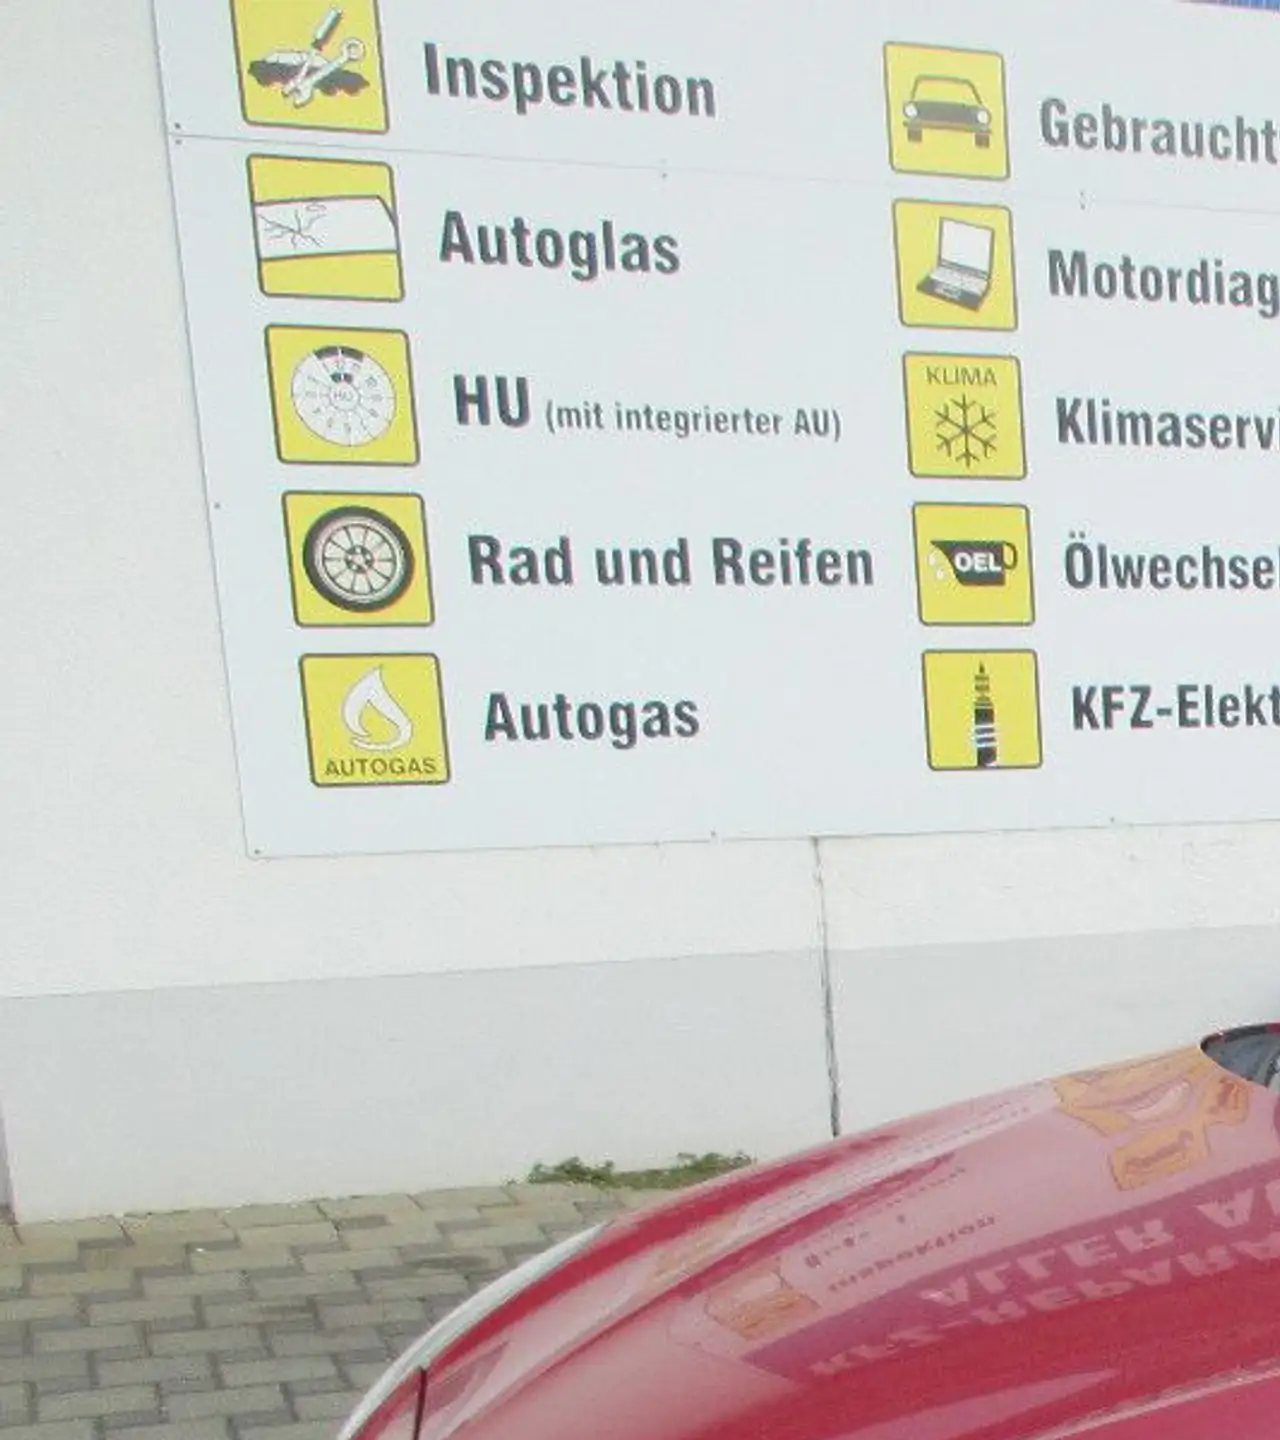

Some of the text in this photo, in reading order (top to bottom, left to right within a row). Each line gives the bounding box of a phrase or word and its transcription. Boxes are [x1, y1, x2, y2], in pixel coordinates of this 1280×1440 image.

[424, 42, 717, 117] Inspektion
[439, 210, 681, 282] Autoglas
[926, 365, 998, 387] KLIMA
[453, 373, 842, 442] HU (mit integrierter AU)
[467, 534, 875, 587] Rad und Reifen
[953, 551, 1004, 572] OEL
[484, 691, 701, 750] Autogas
[325, 757, 437, 777] AUTOGAS
